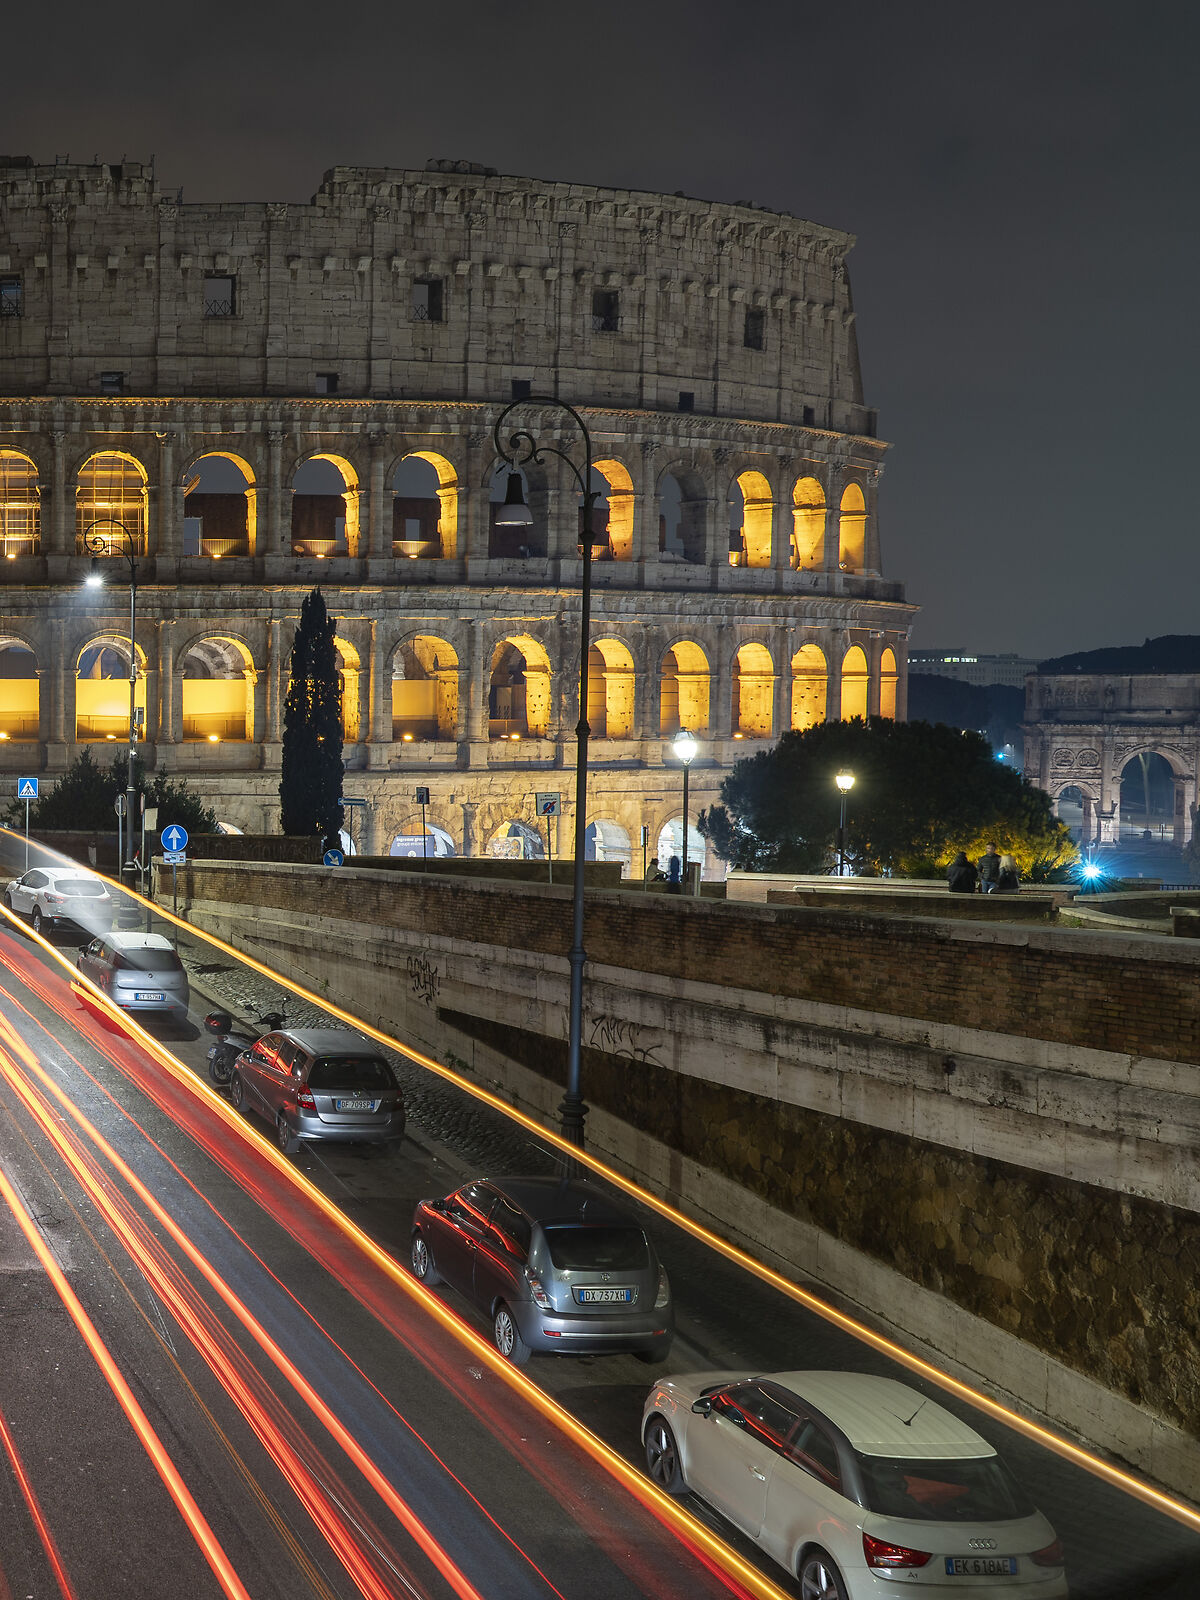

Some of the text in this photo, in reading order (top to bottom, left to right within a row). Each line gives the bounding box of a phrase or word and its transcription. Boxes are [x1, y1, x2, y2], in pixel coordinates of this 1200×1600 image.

[585, 1290, 625, 1301] DX 737XH
[954, 1559, 1009, 1573] EK 618AE
